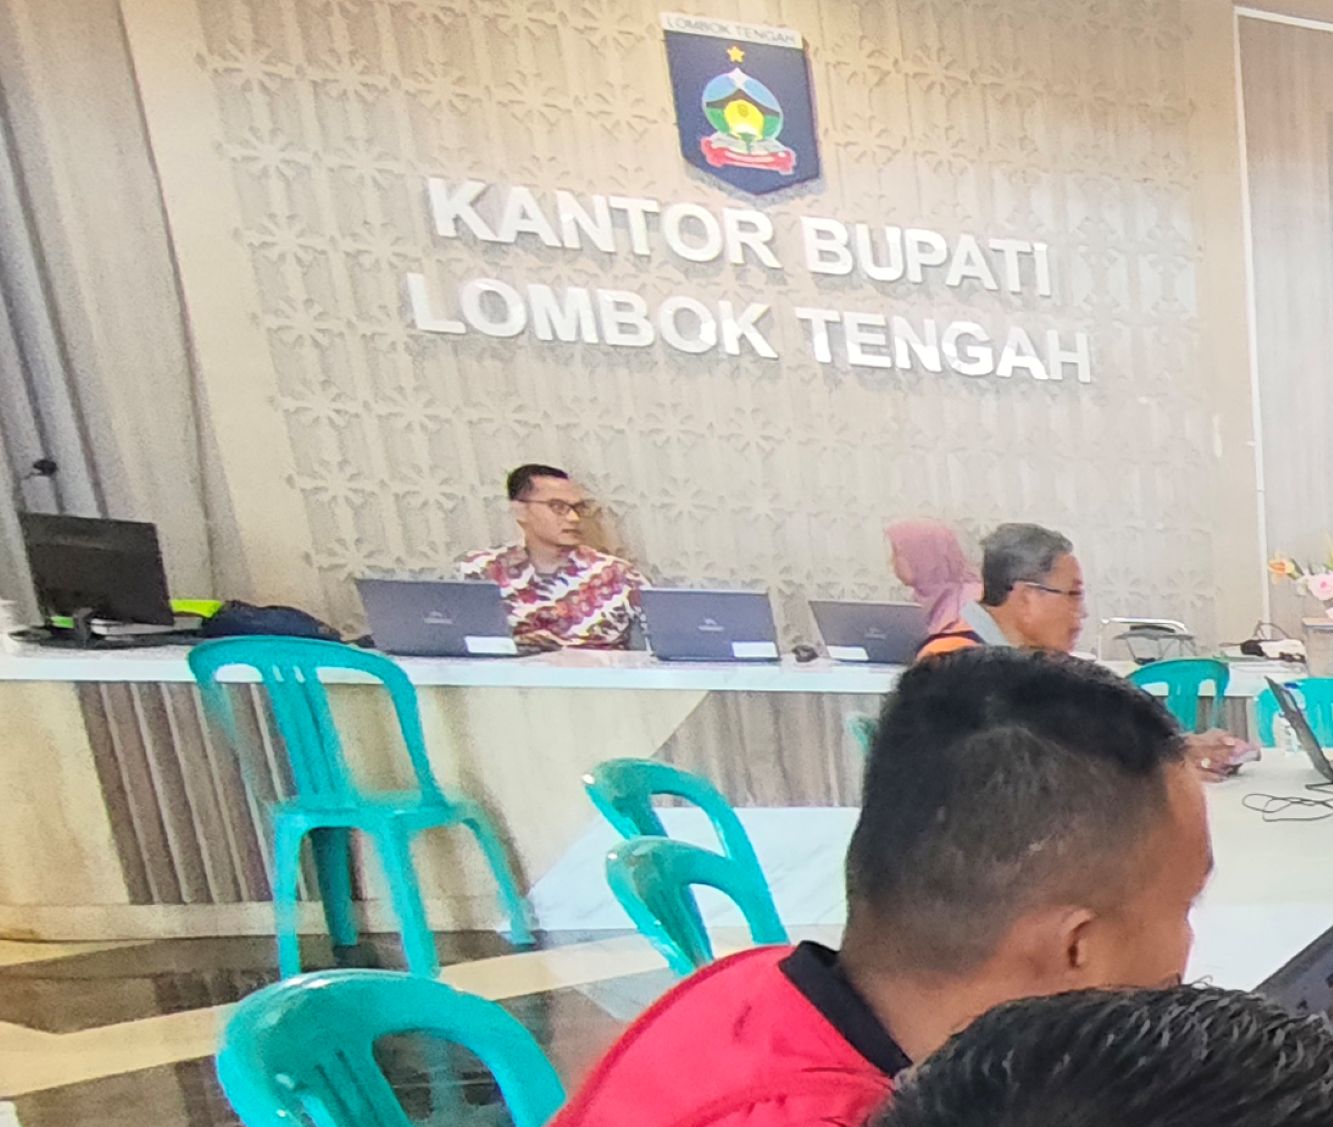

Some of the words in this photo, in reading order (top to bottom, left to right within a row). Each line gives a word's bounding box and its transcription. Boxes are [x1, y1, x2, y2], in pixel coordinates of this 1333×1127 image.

[666, 16, 731, 35] LOMBOK
[735, 25, 796, 43] TENGAH
[427, 177, 782, 270] KANTOR
[800, 215, 1052, 297] BUPATI
[406, 272, 778, 360] LOMBOK
[795, 307, 1093, 383] TENGAH
